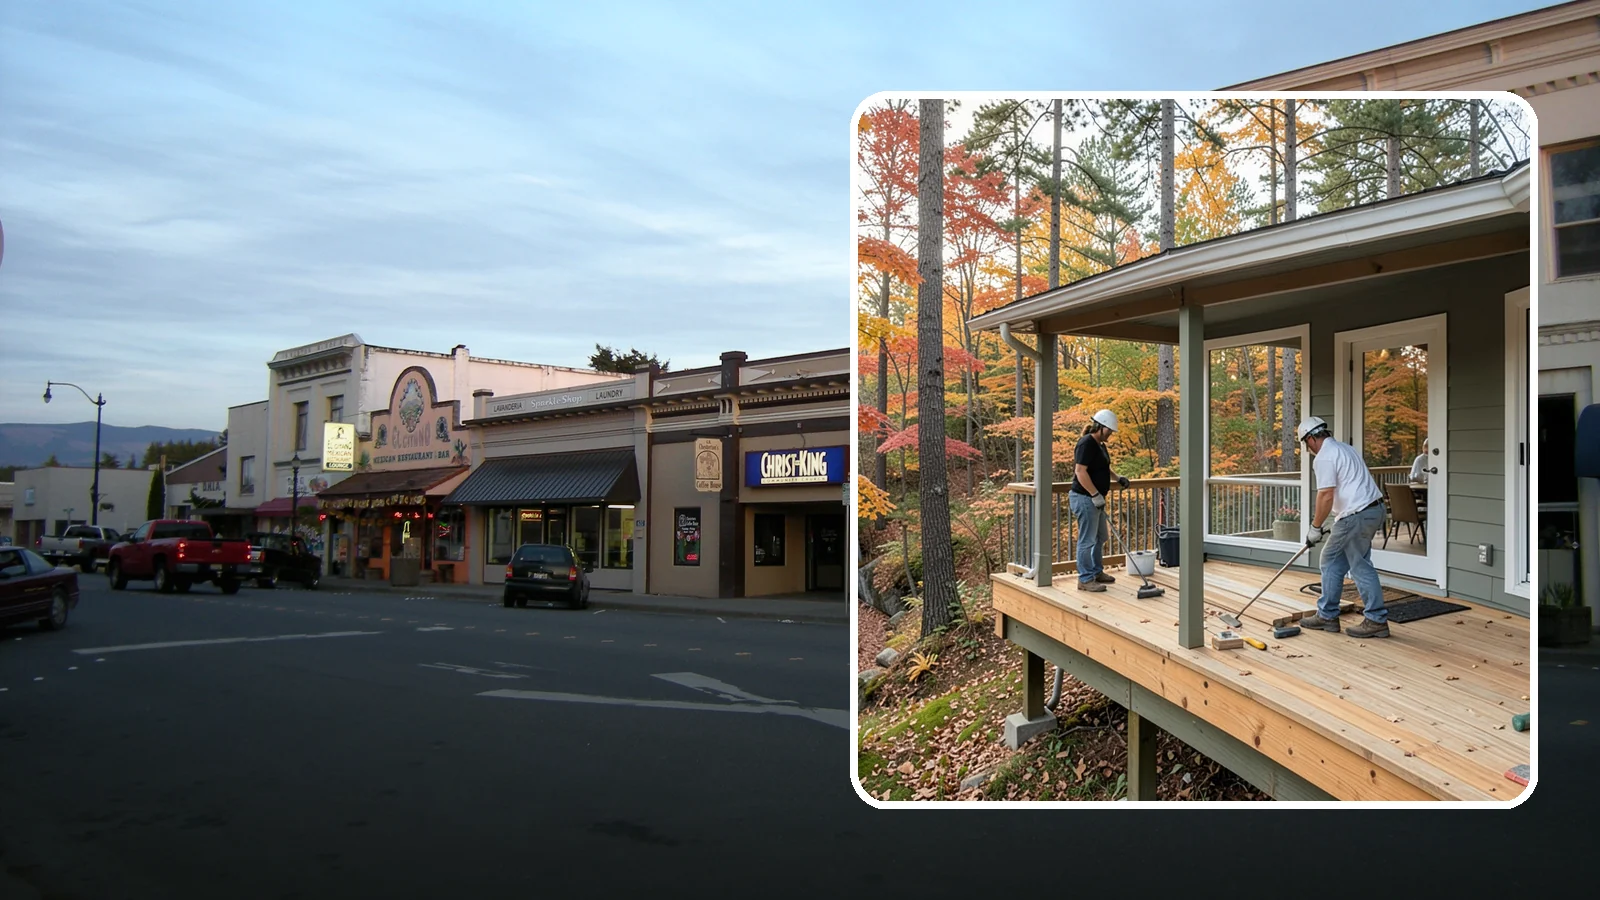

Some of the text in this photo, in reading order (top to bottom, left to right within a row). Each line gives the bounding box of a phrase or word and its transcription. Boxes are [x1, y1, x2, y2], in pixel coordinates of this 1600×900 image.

[531, 394, 583, 408] Sparkle Shop
[595, 389, 624, 400] LAUNDRY
[493, 402, 523, 413] LAVANDERIA
[374, 455, 396, 464] MEXICAN
[397, 451, 434, 462] RESTAURANT
[438, 450, 450, 459] BAR
[761, 450, 827, 478] CHRIST KING
